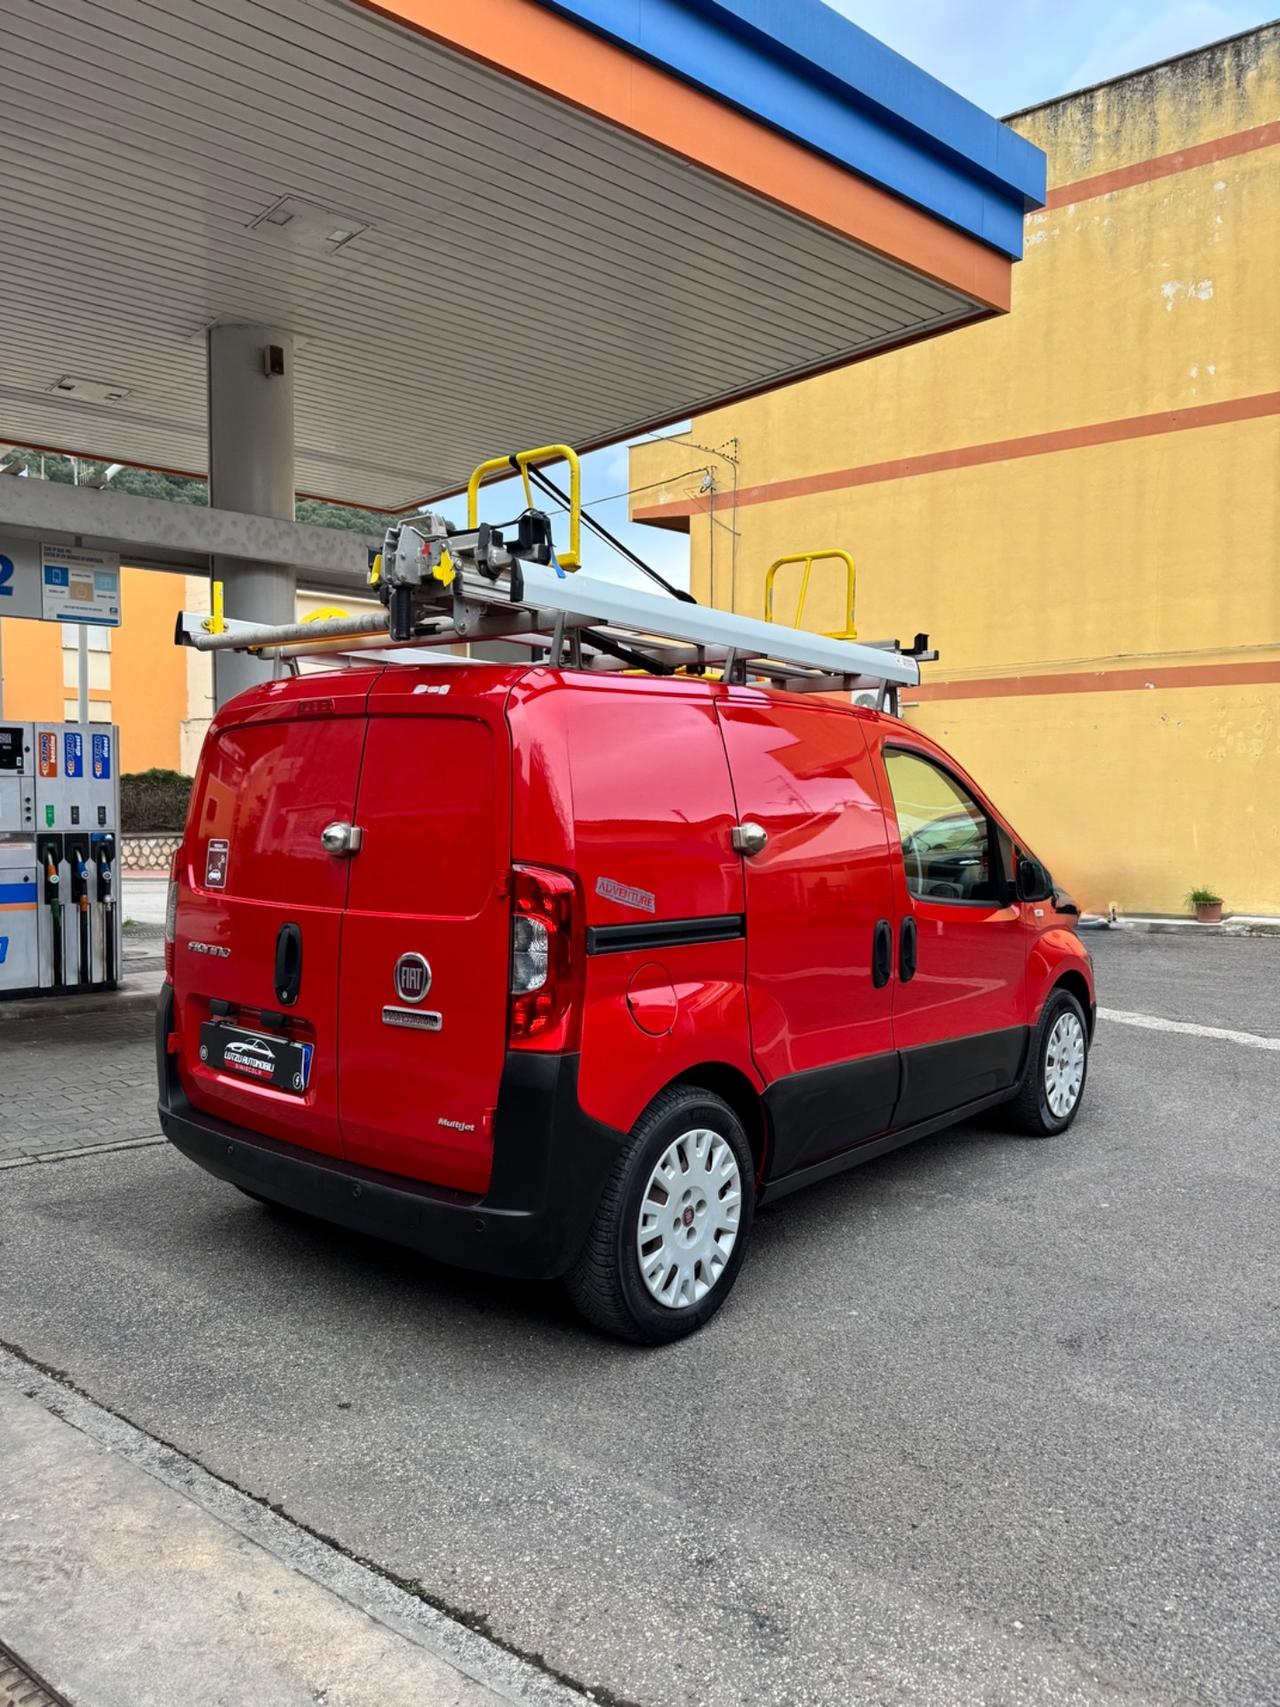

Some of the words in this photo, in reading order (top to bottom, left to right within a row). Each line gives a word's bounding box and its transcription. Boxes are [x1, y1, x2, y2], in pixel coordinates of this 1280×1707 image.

[598, 881, 653, 907] ADVENTURE
[401, 966, 423, 991] FIAT
[437, 1117, 475, 1132] Multijet
